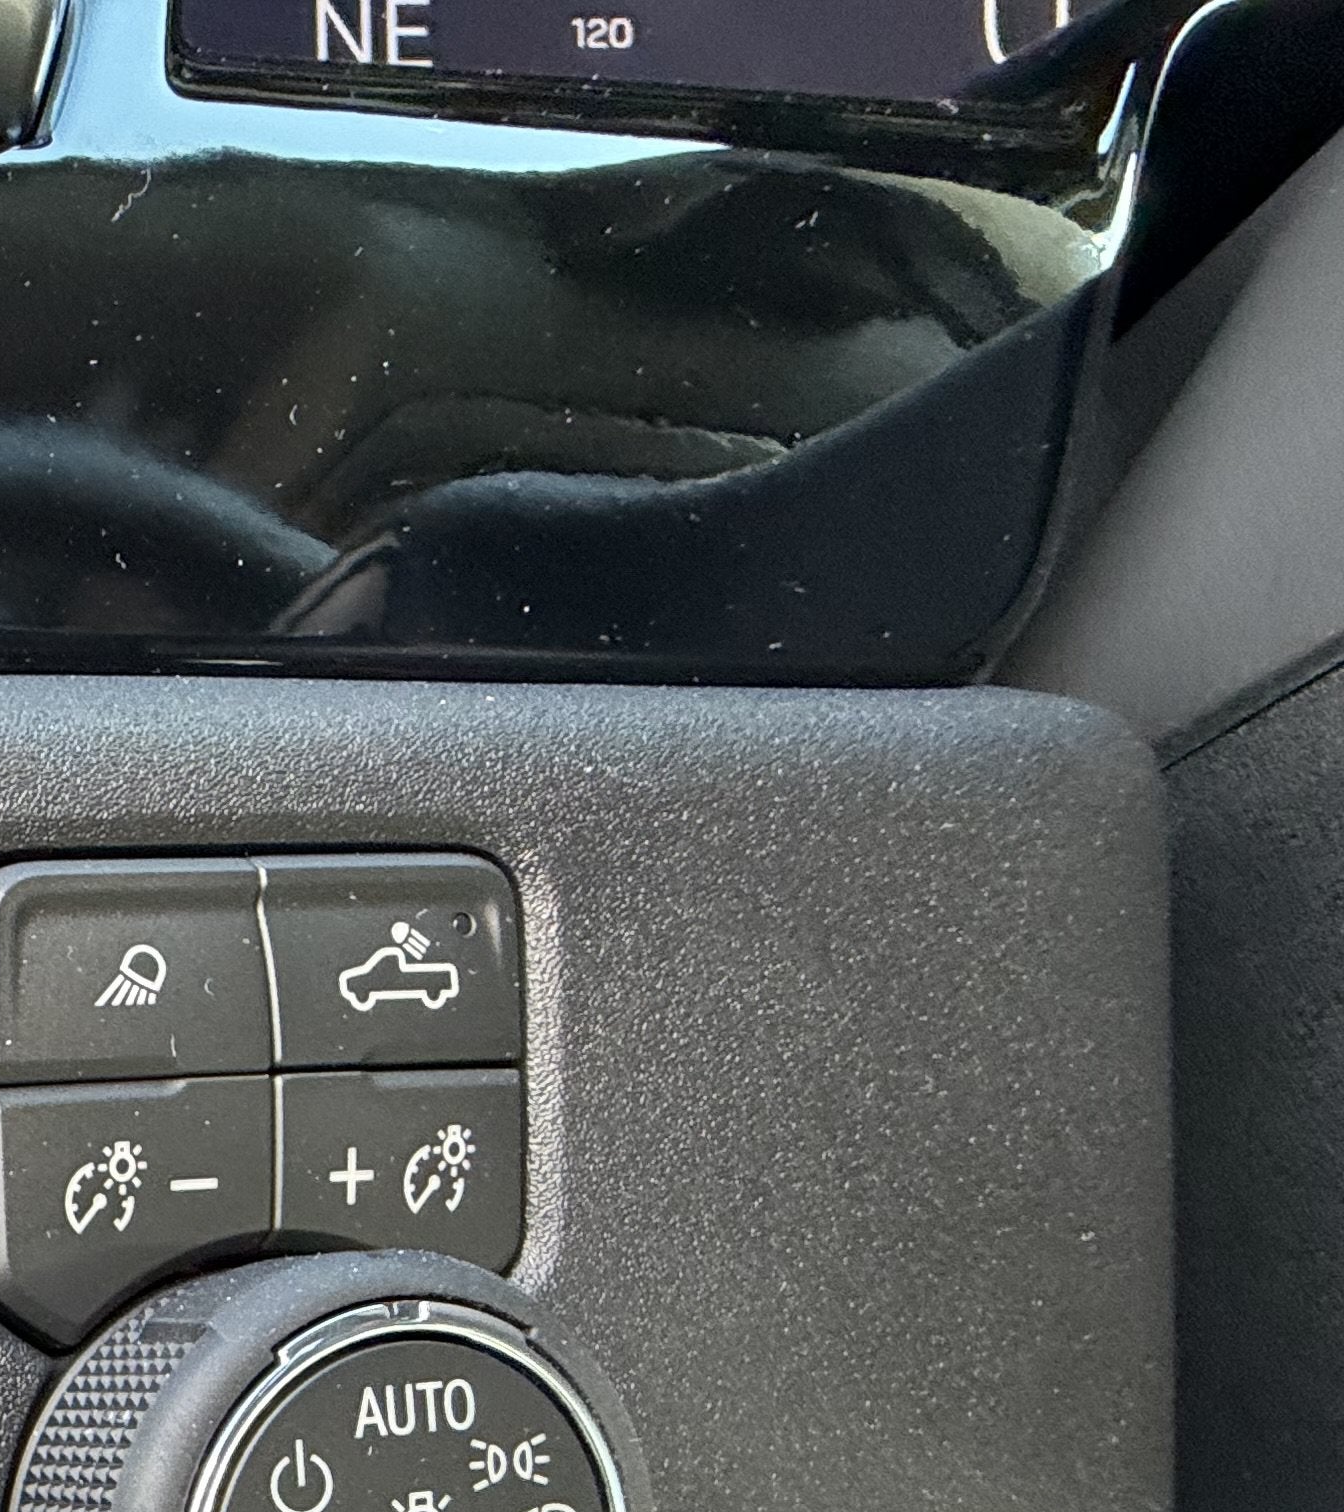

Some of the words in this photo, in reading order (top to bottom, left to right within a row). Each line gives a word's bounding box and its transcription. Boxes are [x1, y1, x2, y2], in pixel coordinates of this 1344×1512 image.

[316, 0, 433, 67] NE
[571, 17, 634, 48] 120
[354, 1378, 476, 1439] AUTO
